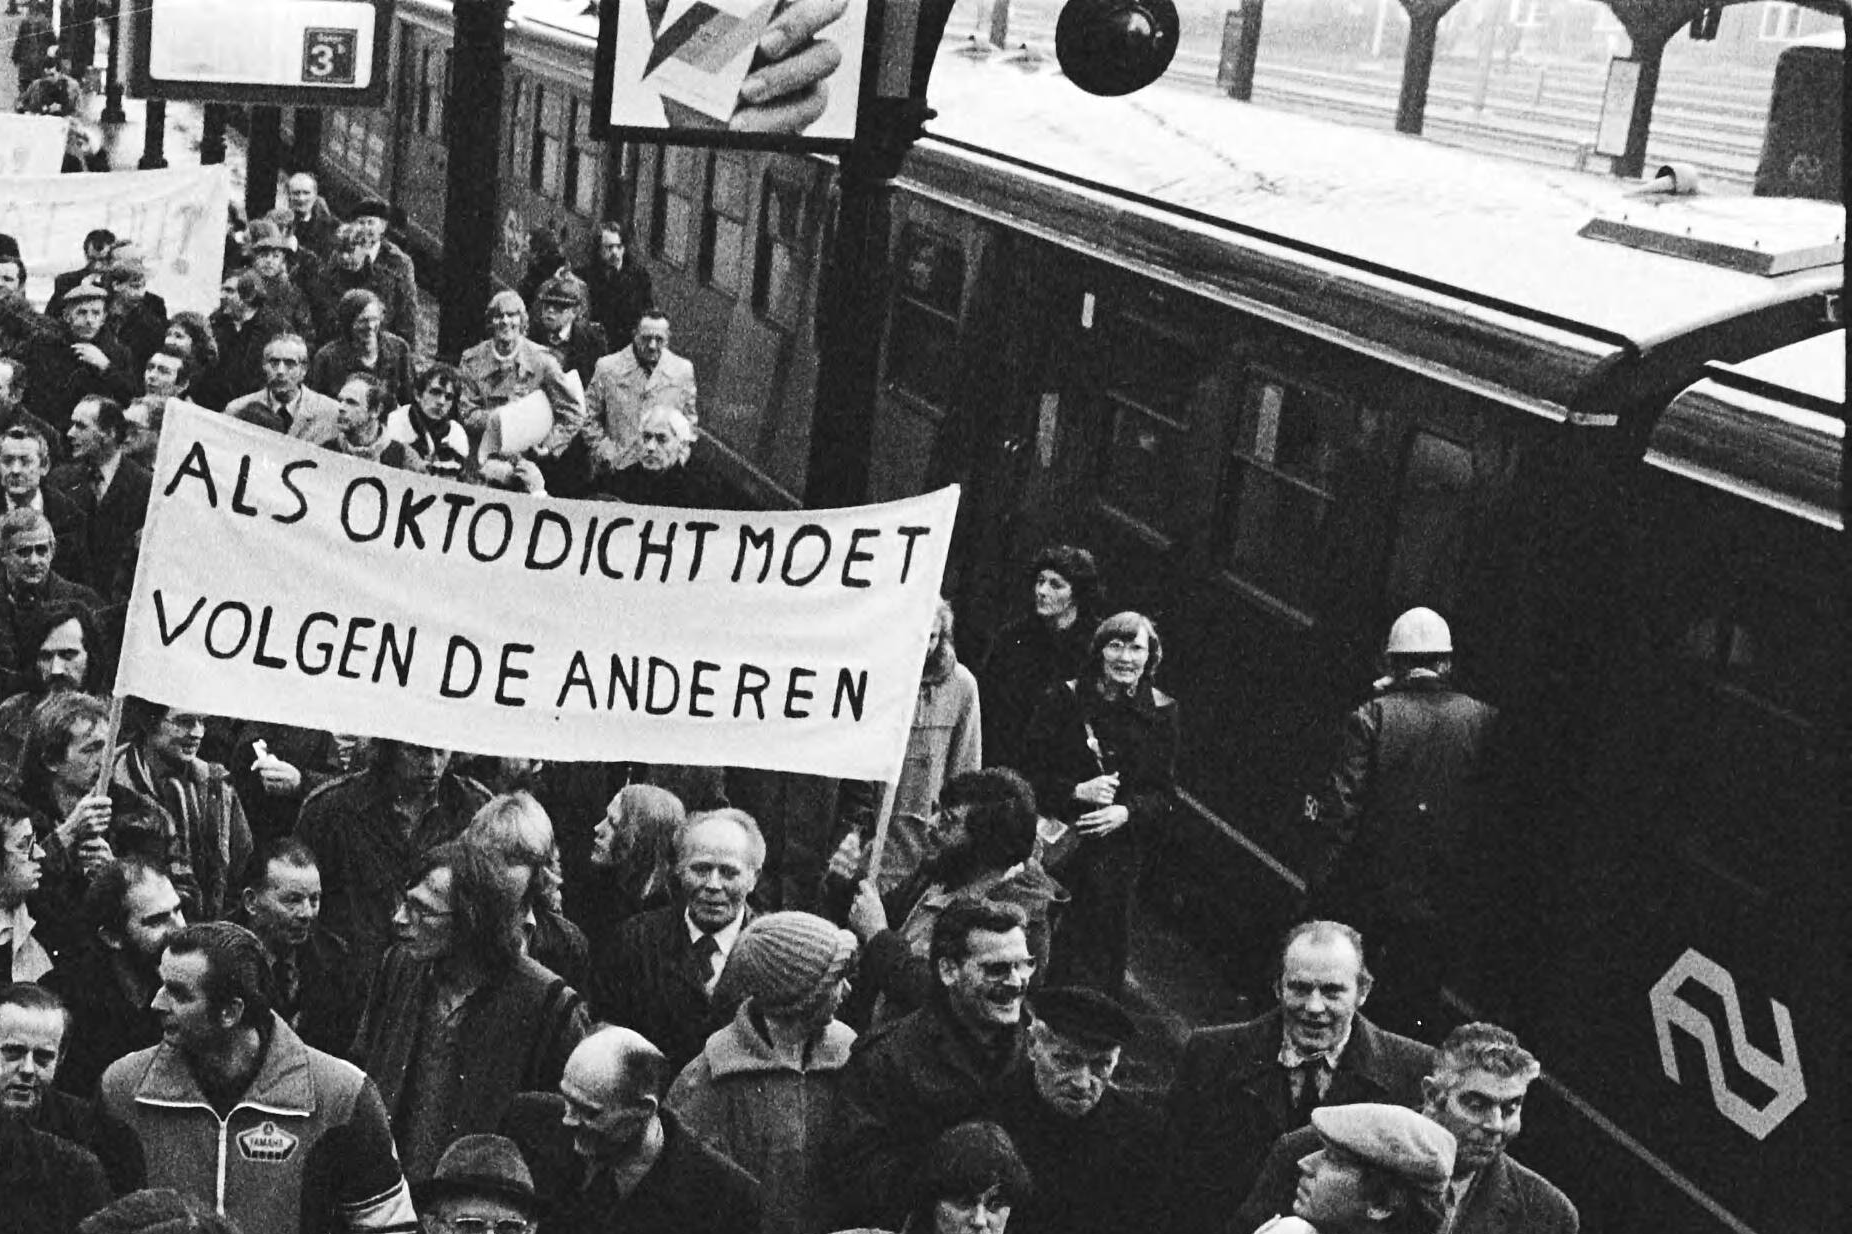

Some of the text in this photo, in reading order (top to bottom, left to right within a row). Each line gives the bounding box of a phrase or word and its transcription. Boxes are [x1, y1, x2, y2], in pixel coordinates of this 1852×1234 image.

[164, 442, 317, 524] ALS
[731, 524, 930, 588] MOET
[153, 590, 867, 721] VOLGEN DE ANDEREN
